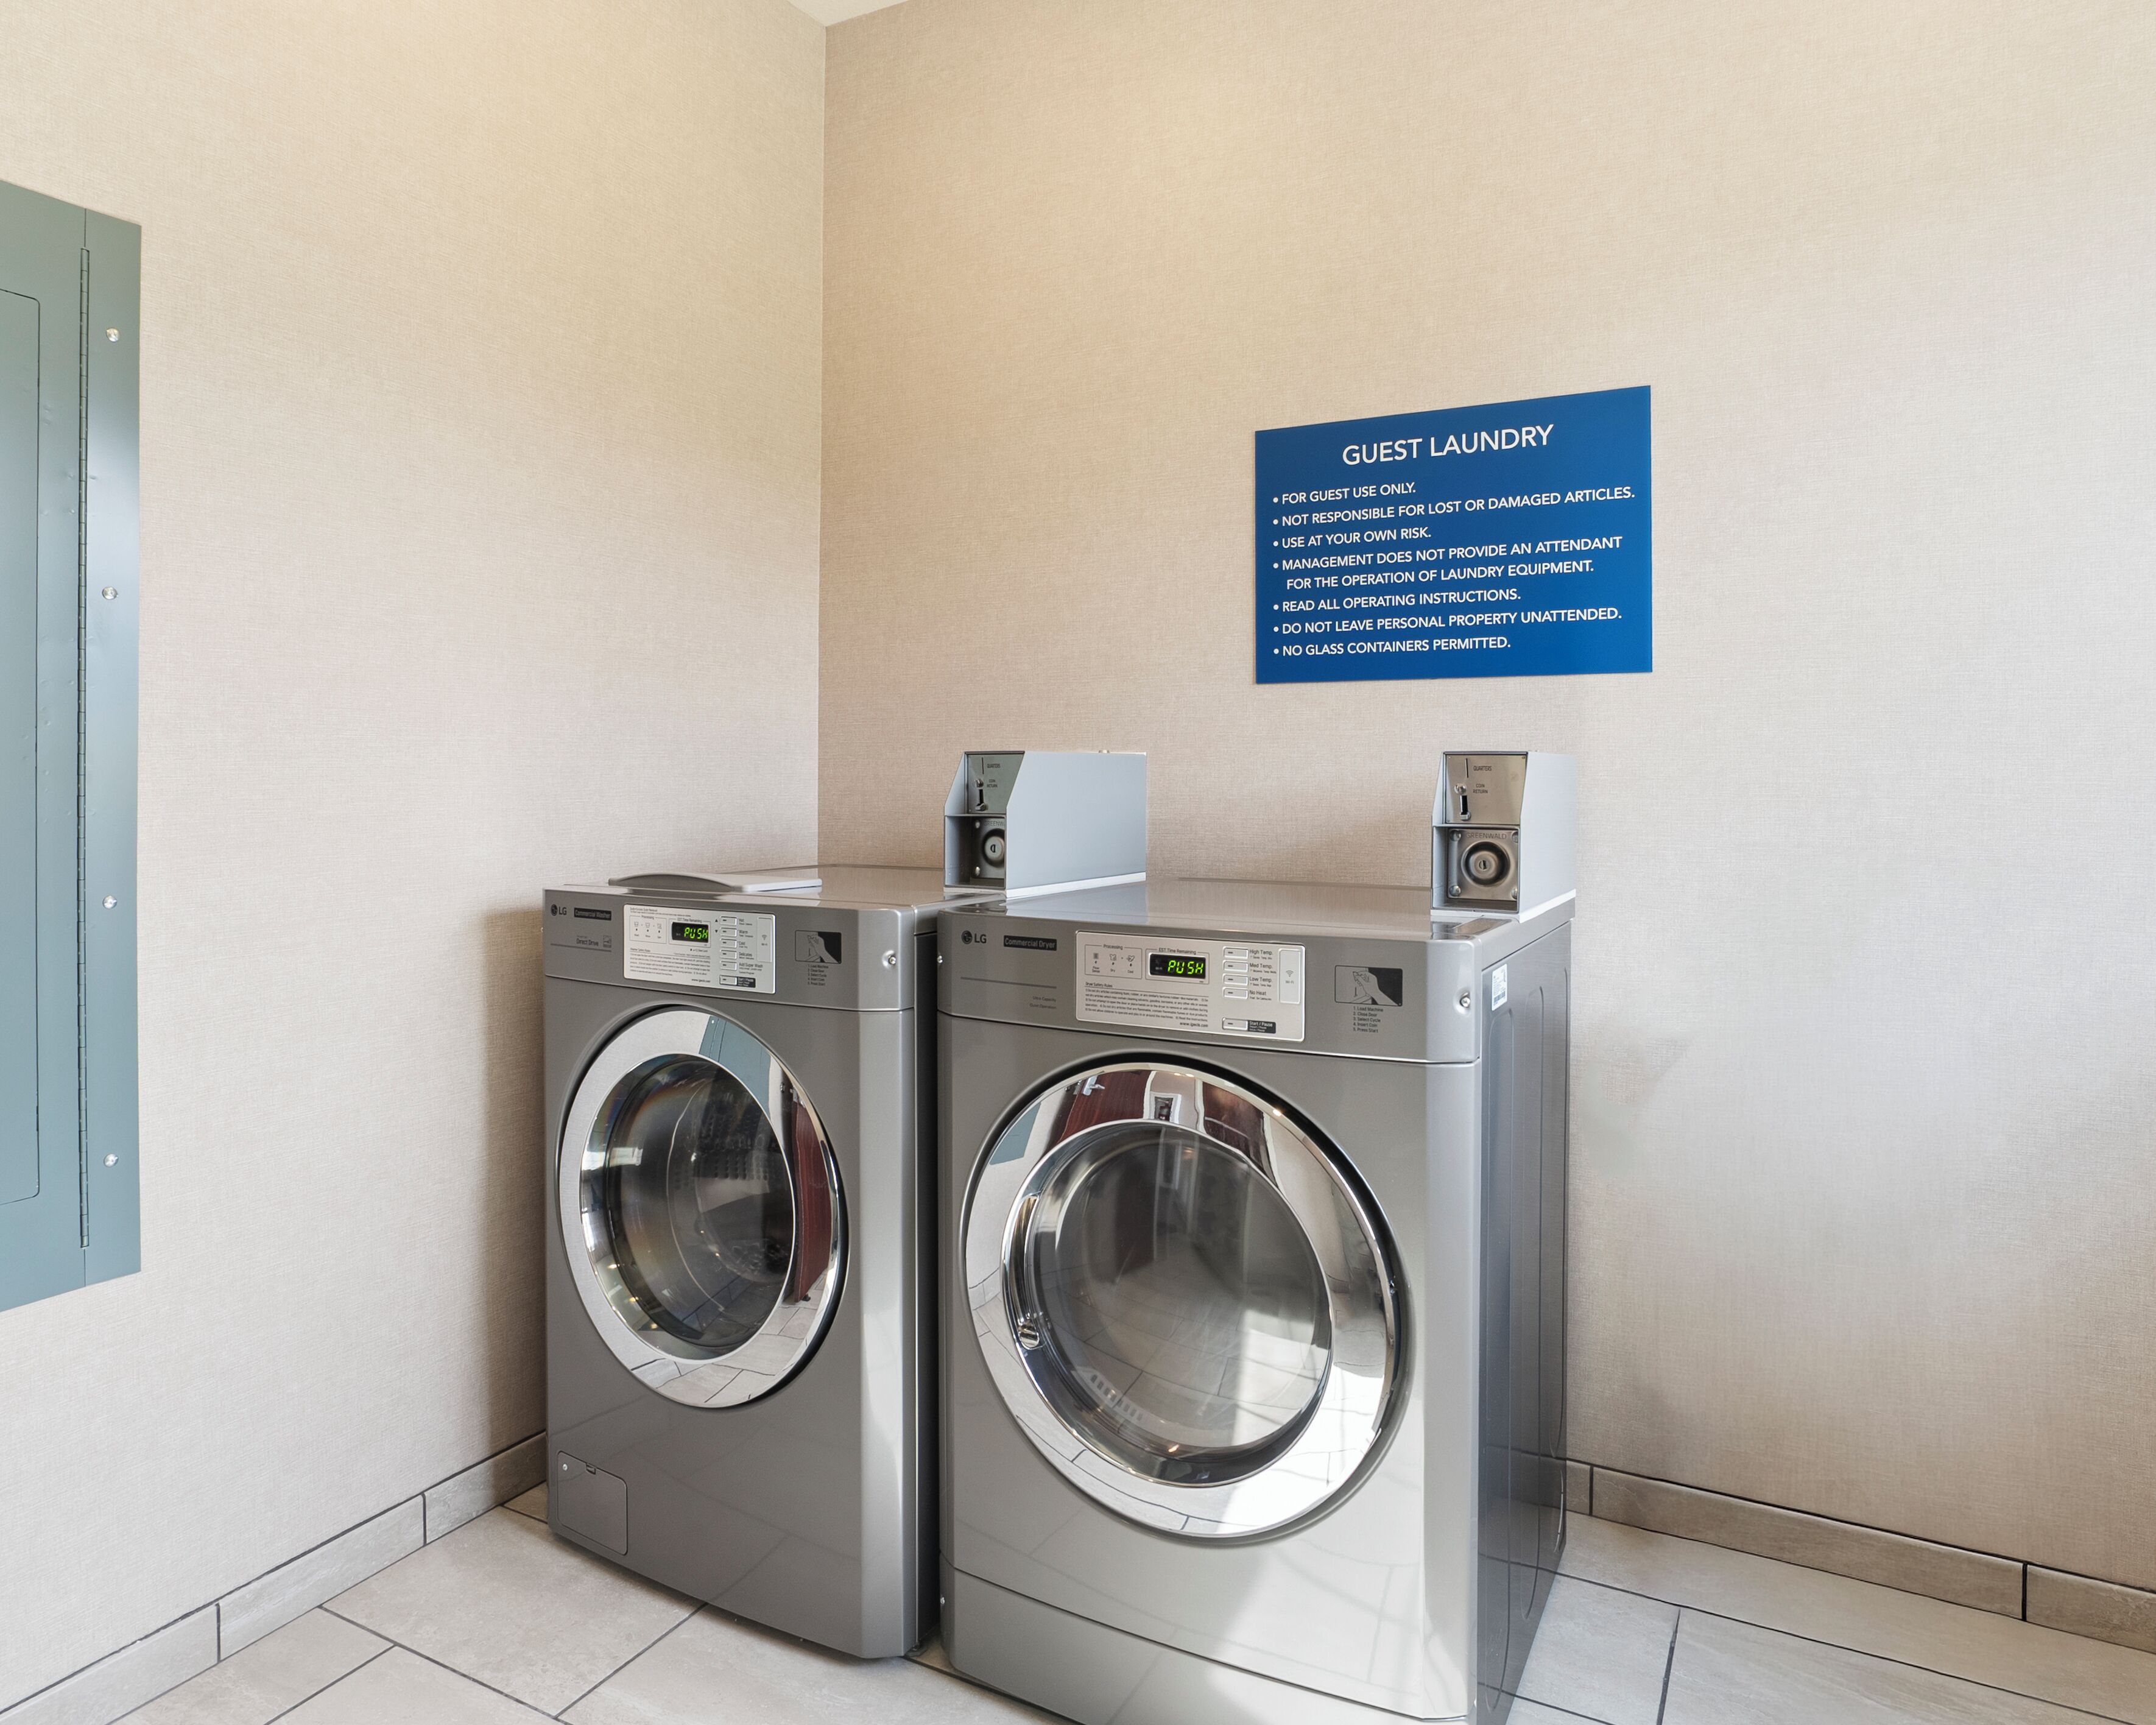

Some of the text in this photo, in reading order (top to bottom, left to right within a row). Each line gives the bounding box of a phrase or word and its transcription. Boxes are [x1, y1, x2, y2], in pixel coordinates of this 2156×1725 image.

[1343, 424, 1554, 465] GUEST LAUNDRY
[1283, 482, 1415, 504] FOR GUEST USE ONLY.
[1283, 487, 1635, 526] NOT RESPONSIBLE FOR LOST OR DAMAGED ARTICLES.
[1283, 527, 1431, 548] USE AT YOUR OWN RISK.
[1283, 537, 1622, 570] MANAGEMENT DOES NOT PROVIDE AN ATTENDANT
[1287, 560, 1593, 590] FOR THE OPERATION OF LAUNDRY EQUIPMENT.
[1283, 588, 1520, 612] READ ALL OPERATING INSTRUCTIONS.
[1283, 608, 1621, 633] DO NOT LEAVE PERSONAL PROPERTY UNATTENDED.
[1283, 637, 1510, 656] NO GLASS CONTAINERS PERMITTED.
[558, 906, 567, 915] LG
[684, 927, 708, 939] PUSH
[974, 934, 987, 944] LG
[1005, 937, 1038, 947] Commercial
[1168, 960, 1203, 975] PUSH
